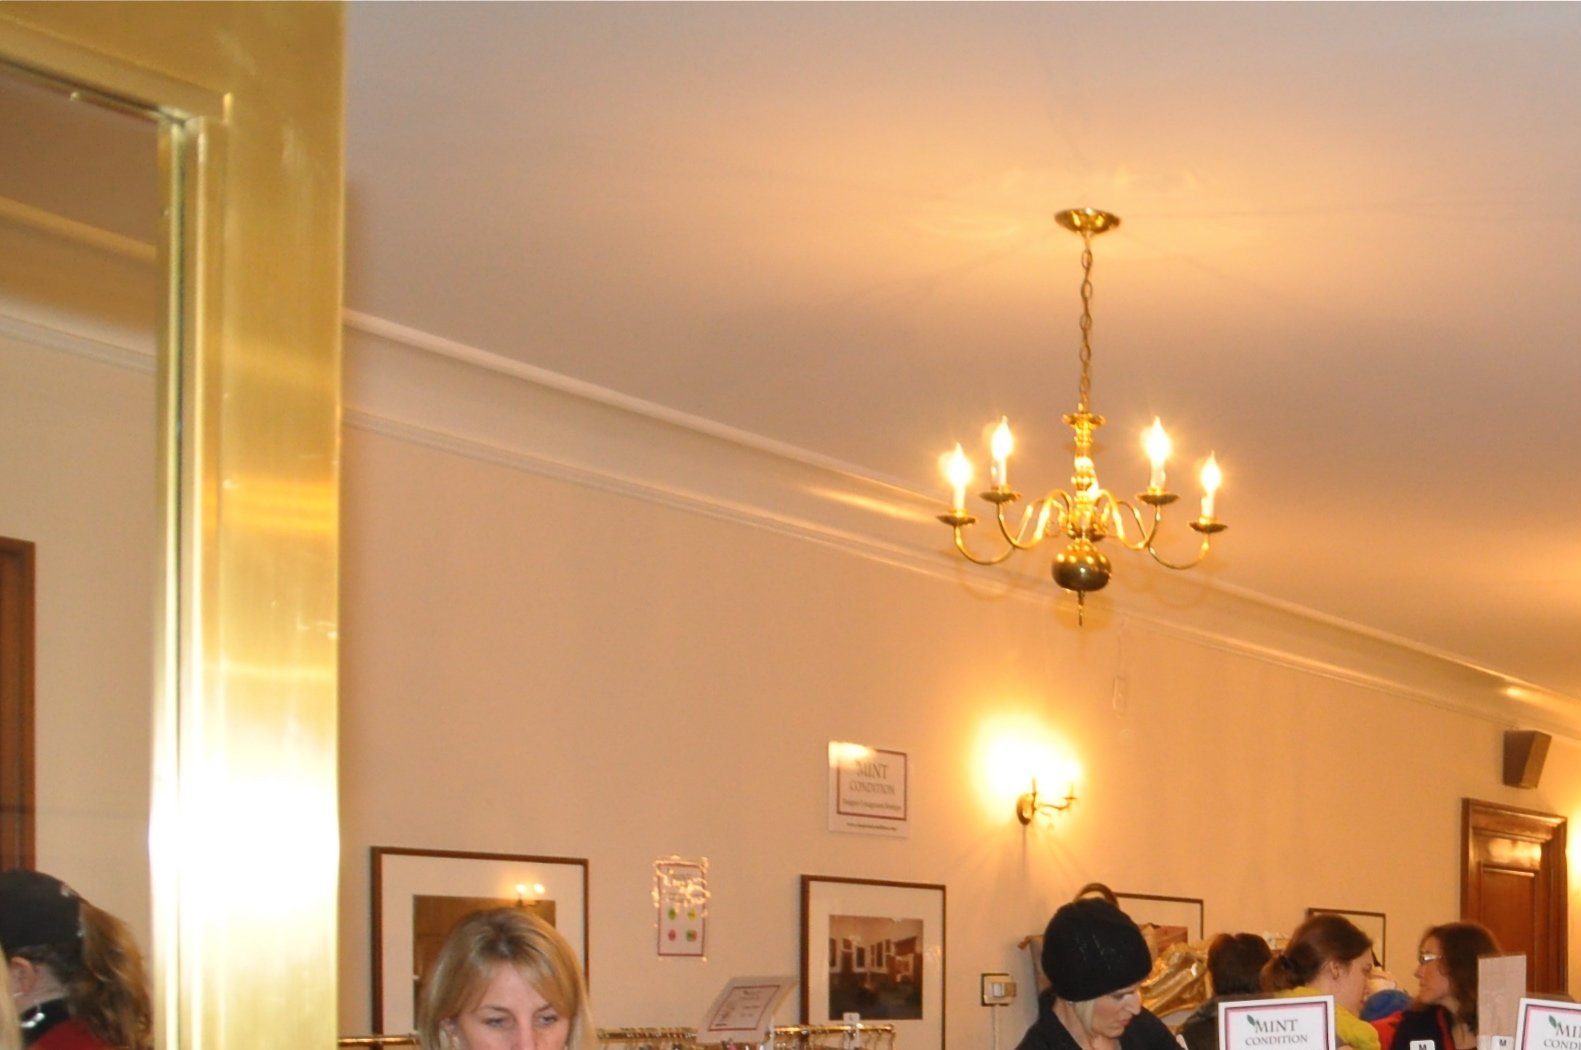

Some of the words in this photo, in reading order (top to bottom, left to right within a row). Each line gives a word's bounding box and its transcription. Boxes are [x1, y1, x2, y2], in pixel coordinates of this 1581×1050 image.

[1254, 1018, 1299, 1033] MINT
[1244, 1034, 1309, 1047] CONDITION
[1499, 1039, 1507, 1047] M
